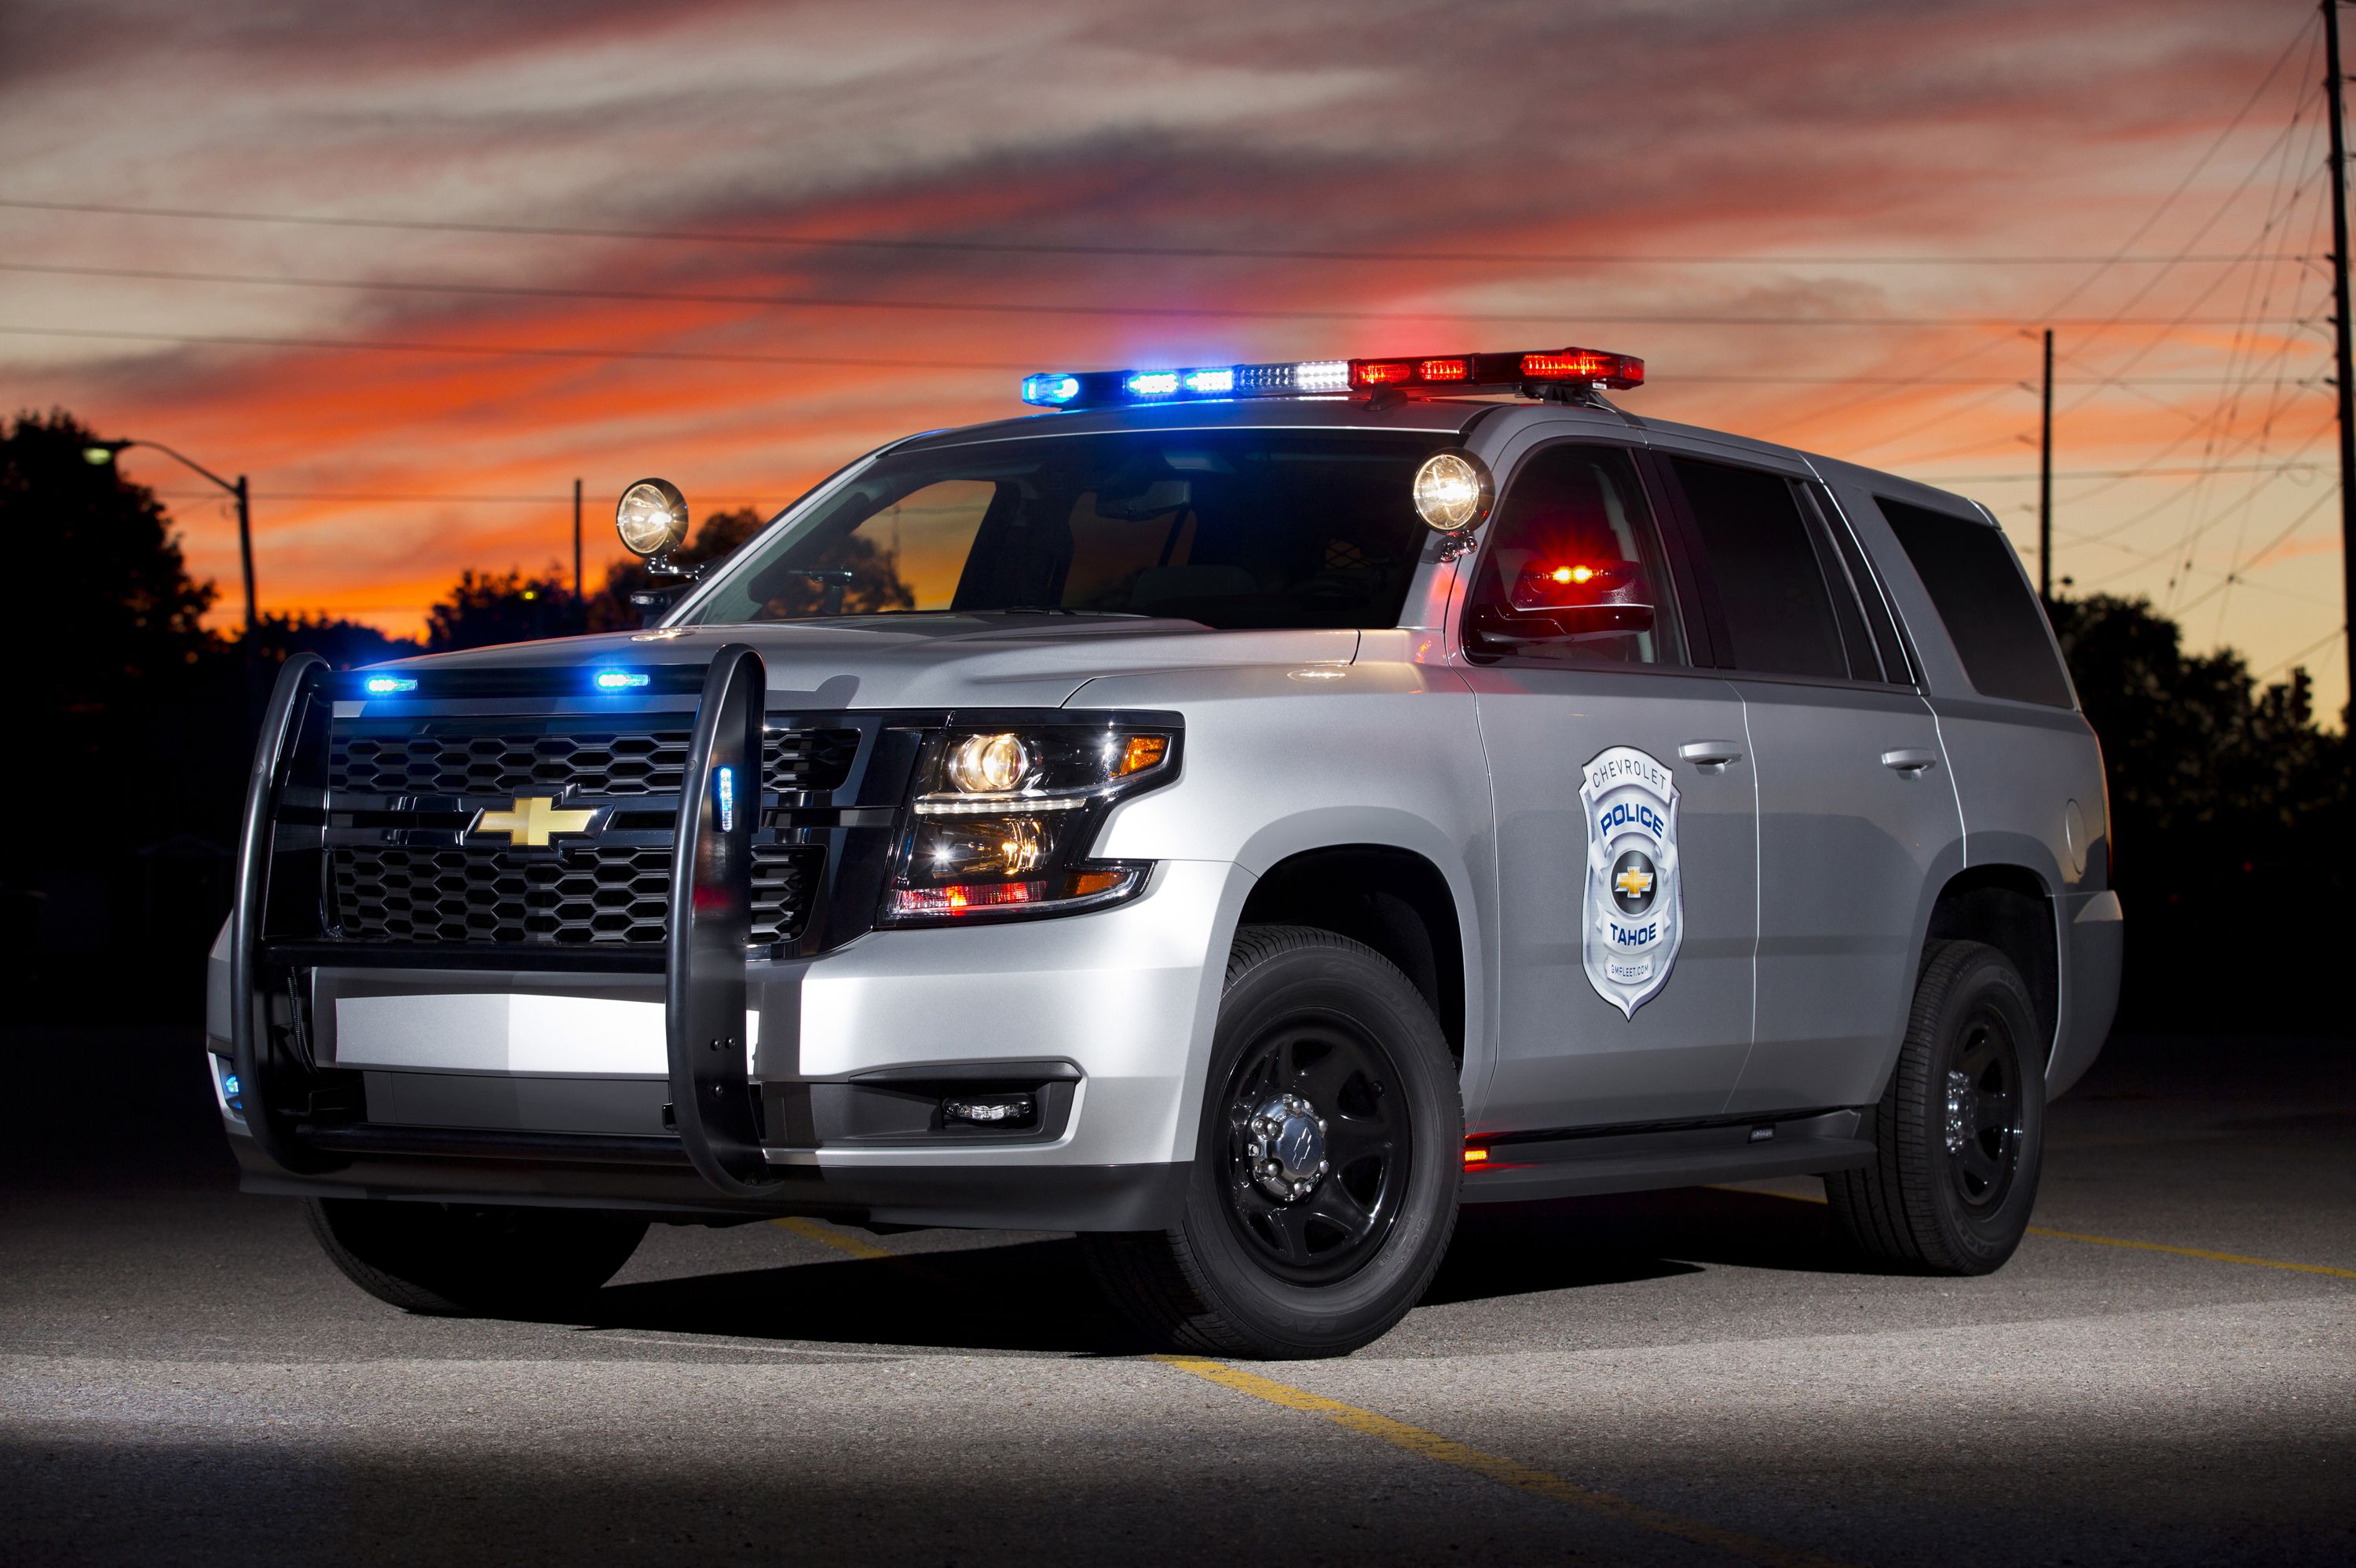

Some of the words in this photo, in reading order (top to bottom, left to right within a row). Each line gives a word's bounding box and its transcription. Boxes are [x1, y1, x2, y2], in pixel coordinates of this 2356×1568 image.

[1593, 758, 1666, 790] CHEVROLET
[1600, 803, 1664, 839] POLICE
[1610, 922, 1656, 945] TAHOE
[1611, 964, 1648, 977] GMFLEET.COM
